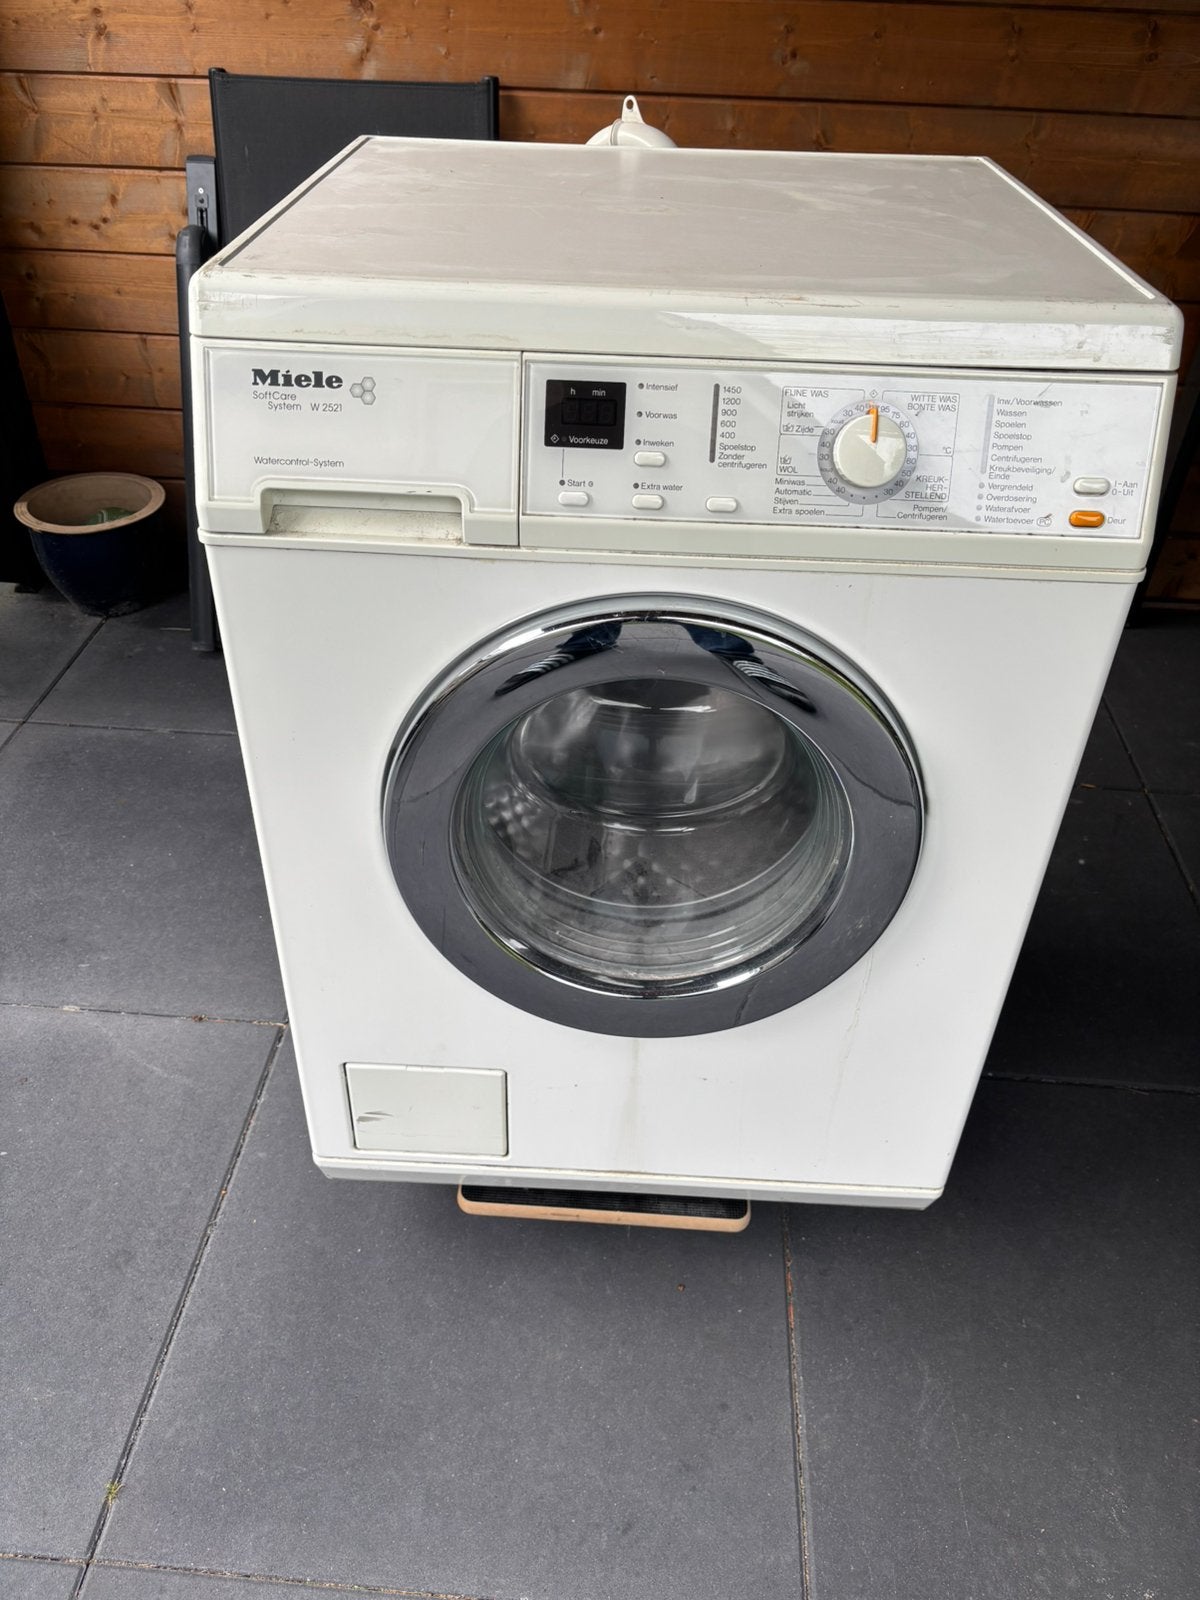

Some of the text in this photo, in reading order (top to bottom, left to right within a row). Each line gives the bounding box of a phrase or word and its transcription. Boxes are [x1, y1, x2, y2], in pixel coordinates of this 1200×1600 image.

[252, 368, 344, 389] Miele
[570, 387, 576, 396] h
[592, 387, 606, 397] min
[646, 383, 678, 392] Intensief
[723, 386, 742, 394] 1450
[253, 390, 297, 401] SoftCare
[784, 389, 829, 398] FIJNE WAS
[722, 397, 741, 405] 1200
[911, 394, 958, 403] WITTE WAS
[268, 401, 343, 412] System W 2521
[787, 402, 806, 410] Licht
[855, 404, 865, 412] 40
[907, 403, 957, 412] BONTE WAS
[645, 411, 678, 420] Voorwas
[721, 409, 737, 417] 900
[787, 410, 814, 419] strijken
[843, 409, 853, 417] 30
[996, 409, 1027, 417] Wassen
[720, 420, 736, 428] 600
[995, 420, 1027, 429] Spoelen
[795, 425, 814, 434] Zijde
[825, 428, 835, 436] 30
[719, 431, 736, 439] 400
[993, 432, 1032, 441] Spoelstop
[568, 435, 609, 445] Voorkeuze
[643, 439, 675, 447] Inweken
[719, 443, 757, 452] Spoelstop
[991, 443, 1023, 452] Pompen
[718, 452, 745, 461] Zonder
[819, 453, 830, 461] 30
[991, 454, 1043, 463] Centrifugeren
[254, 456, 345, 468] Watercontrol-System
[717, 461, 768, 470] centrifugeren
[778, 465, 799, 474] WOL
[989, 465, 1057, 476] Kreukbeveiliging/
[827, 477, 838, 485] 40
[915, 475, 949, 483] KREUK-
[988, 473, 1010, 481] Einde
[567, 479, 587, 488] Start
[775, 478, 806, 486] Miniwas
[641, 482, 683, 492] Extra water
[774, 487, 813, 496] Automatic
[836, 486, 846, 494] 40
[925, 484, 948, 492] HER-
[987, 483, 1034, 492] Vergrendeld
[905, 491, 948, 500] STELLEND
[986, 494, 1037, 504] Overdosering
[773, 497, 799, 506] Stijven
[772, 507, 825, 517] Extra spoelen
[912, 504, 948, 514] Pompen/
[985, 505, 1031, 514] Waterafvoer
[897, 512, 948, 521] Centrifugeren
[984, 515, 1034, 525] Watertoevoer
[1107, 517, 1126, 525] Deur
